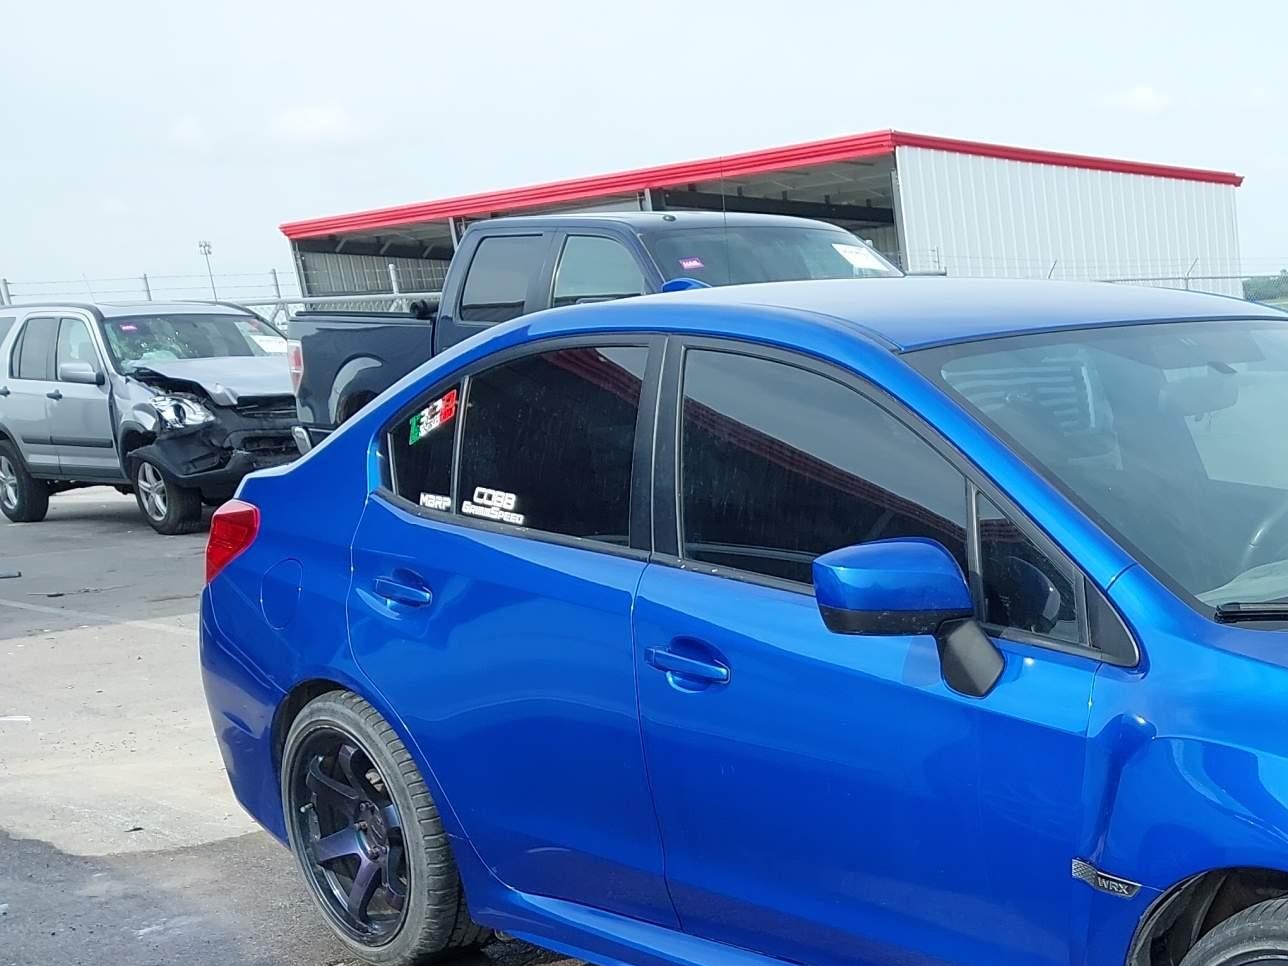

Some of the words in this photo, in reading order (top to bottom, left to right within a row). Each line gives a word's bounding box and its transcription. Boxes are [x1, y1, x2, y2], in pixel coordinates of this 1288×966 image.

[419, 492, 451, 510] MBRP
[473, 486, 516, 511] COBB
[1097, 876, 1129, 895] WRX
